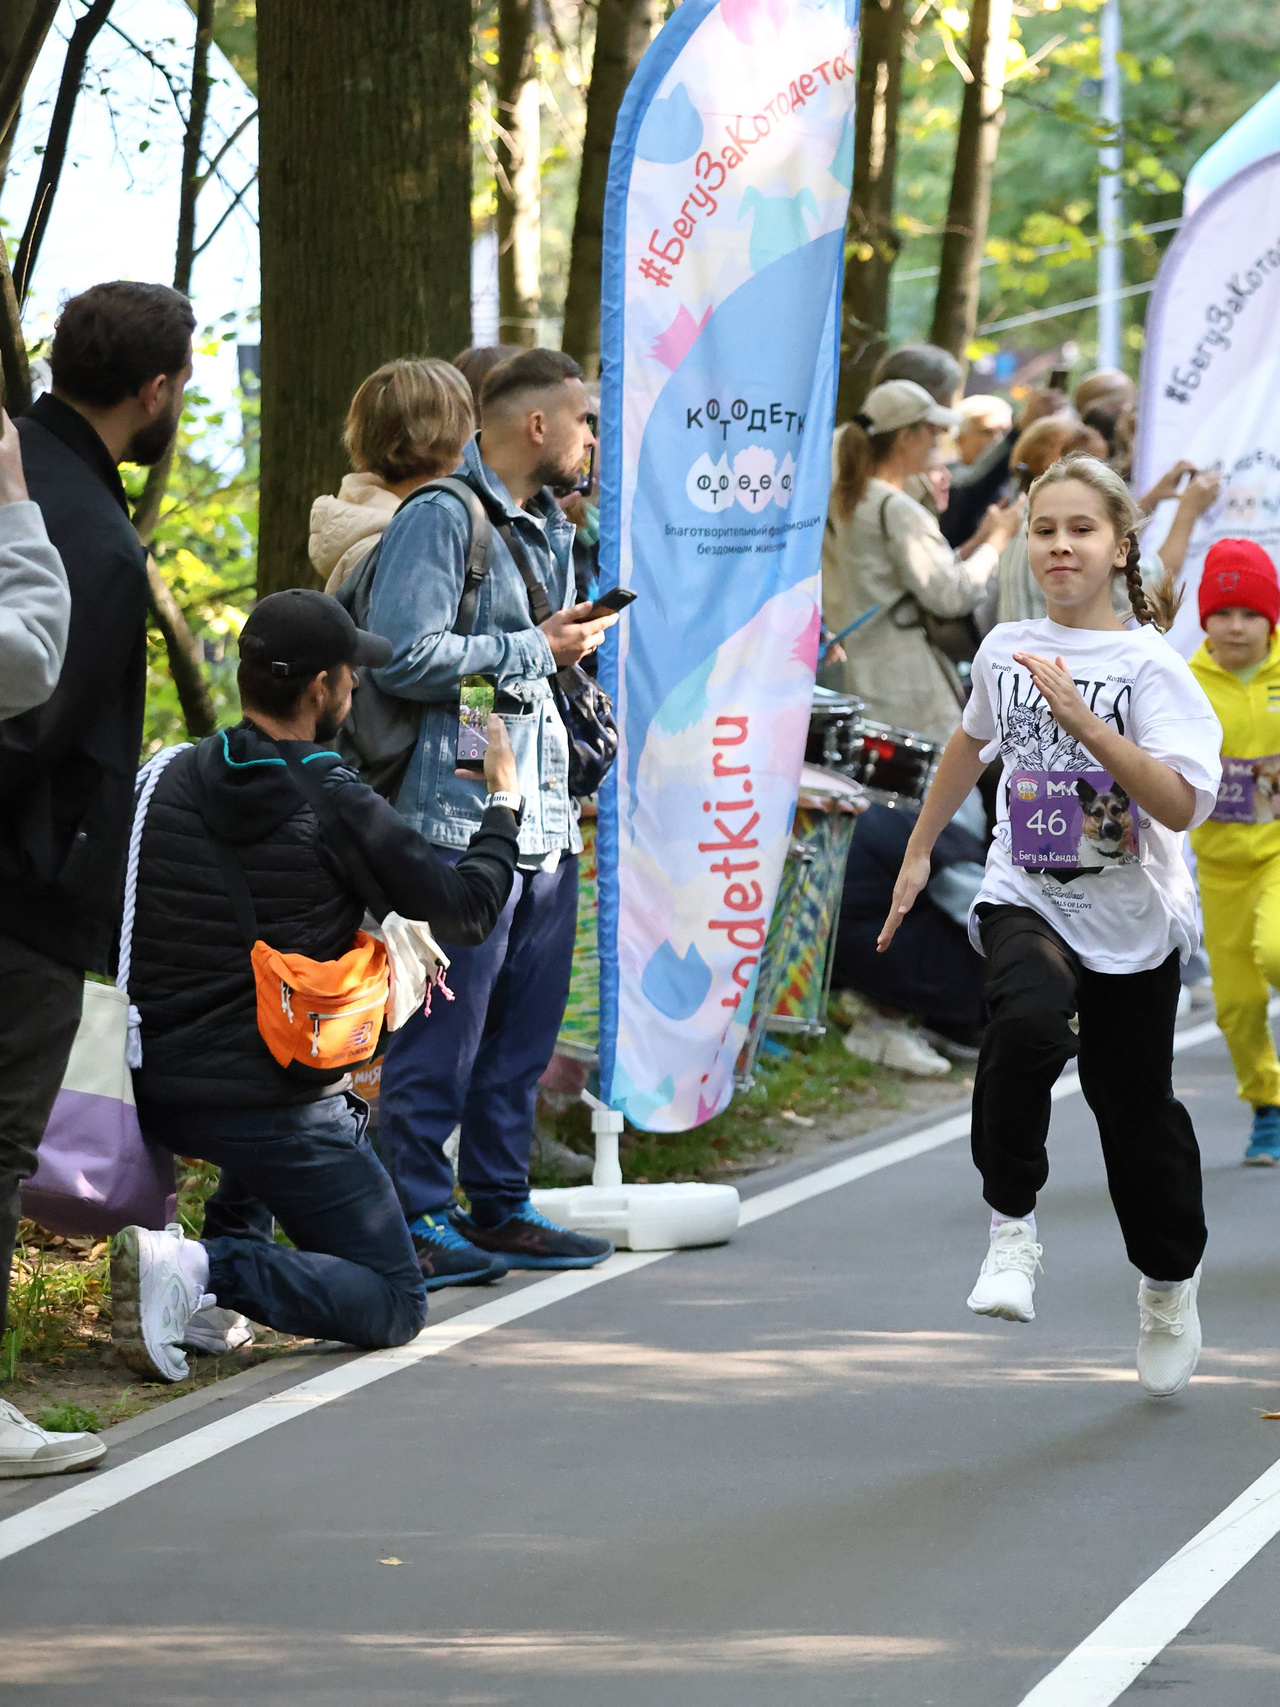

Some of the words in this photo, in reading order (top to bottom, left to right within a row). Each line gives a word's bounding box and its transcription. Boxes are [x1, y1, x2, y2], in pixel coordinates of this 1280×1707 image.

[991, 662, 1013, 673] Beauty
[1026, 808, 1067, 836] 46
[1019, 850, 1037, 864] Бегу
[1038, 854, 1048, 862] за
